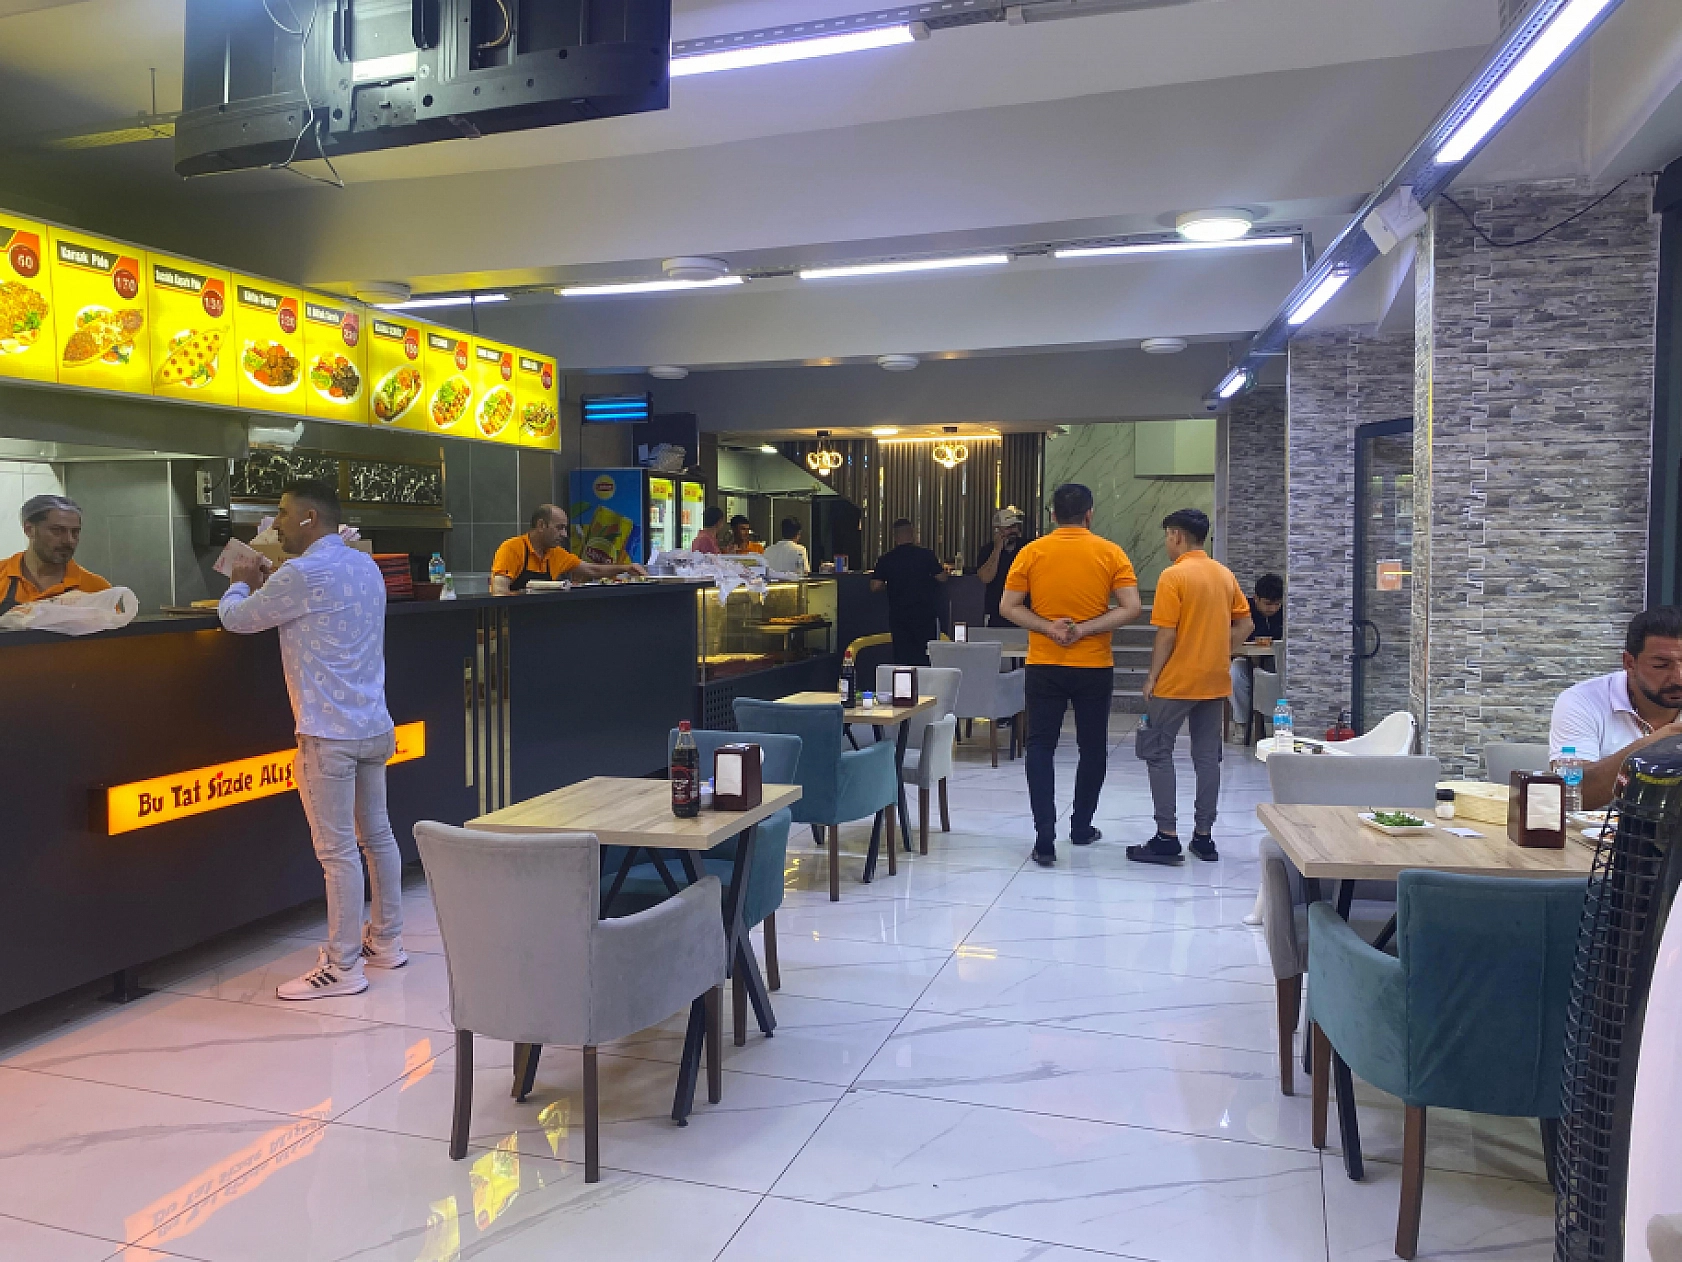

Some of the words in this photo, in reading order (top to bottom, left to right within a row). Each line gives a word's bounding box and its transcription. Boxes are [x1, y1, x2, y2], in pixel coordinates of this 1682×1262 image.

[138, 792, 164, 817] Bu
[171, 779, 201, 808] Tat
[208, 771, 253, 800] Sizde
[259, 762, 294, 788] Alış
